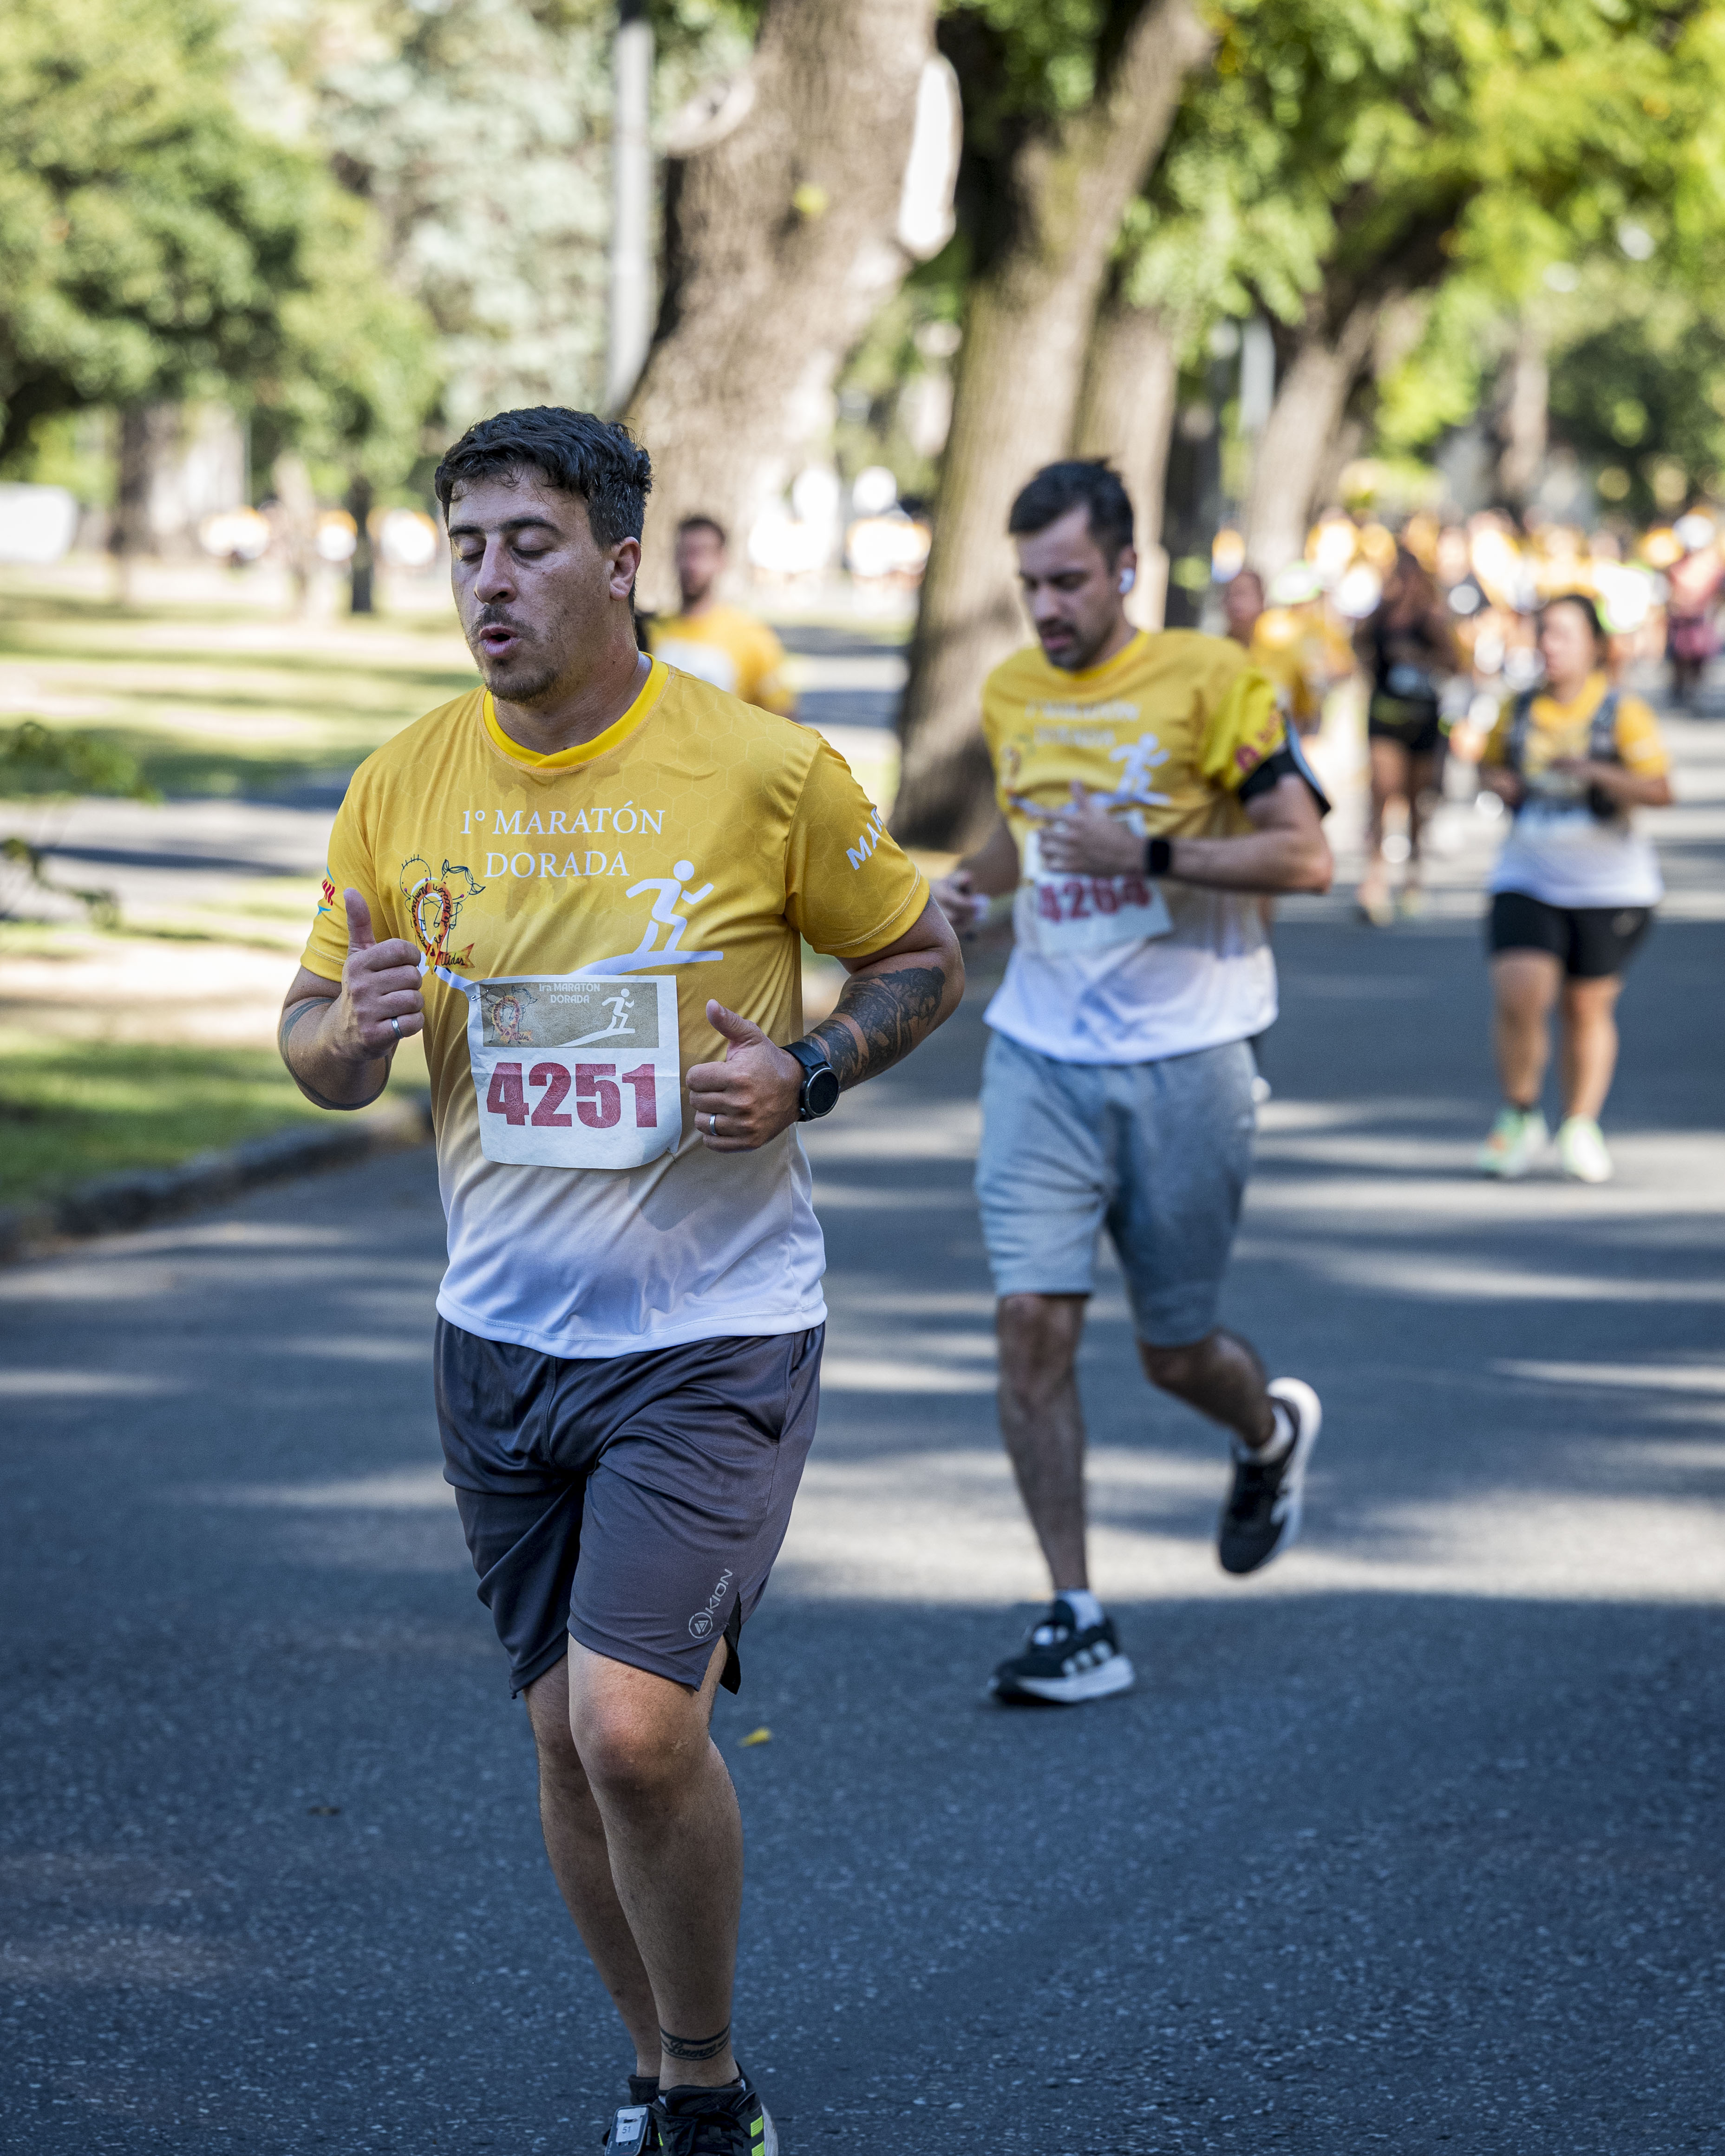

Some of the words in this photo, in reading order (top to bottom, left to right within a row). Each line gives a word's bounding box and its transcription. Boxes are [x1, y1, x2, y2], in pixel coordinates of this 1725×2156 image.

[492, 800, 666, 834] MARATÓN
[484, 851, 630, 878] DORADA
[550, 994, 590, 1003] DORADA
[486, 1062, 657, 1128] 4251
[705, 1569, 733, 1615] KION
